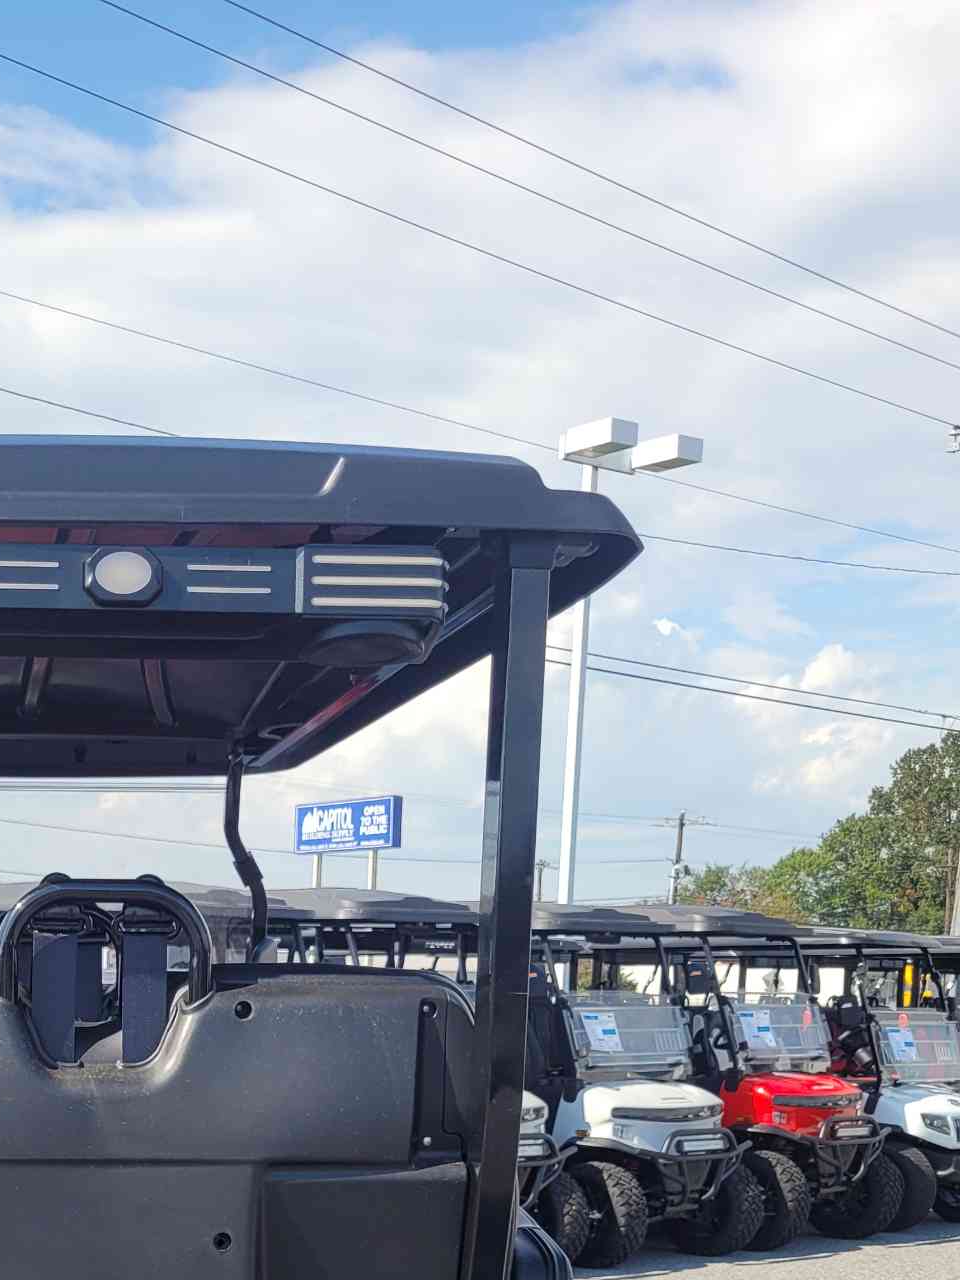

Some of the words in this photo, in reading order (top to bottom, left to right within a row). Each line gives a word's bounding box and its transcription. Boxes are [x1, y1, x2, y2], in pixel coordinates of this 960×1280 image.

[363, 805, 385, 816] OPEN
[317, 808, 354, 832] CAPITOL
[360, 816, 371, 827] TO
[372, 814, 388, 826] THE
[360, 825, 388, 836] PUBLIC
